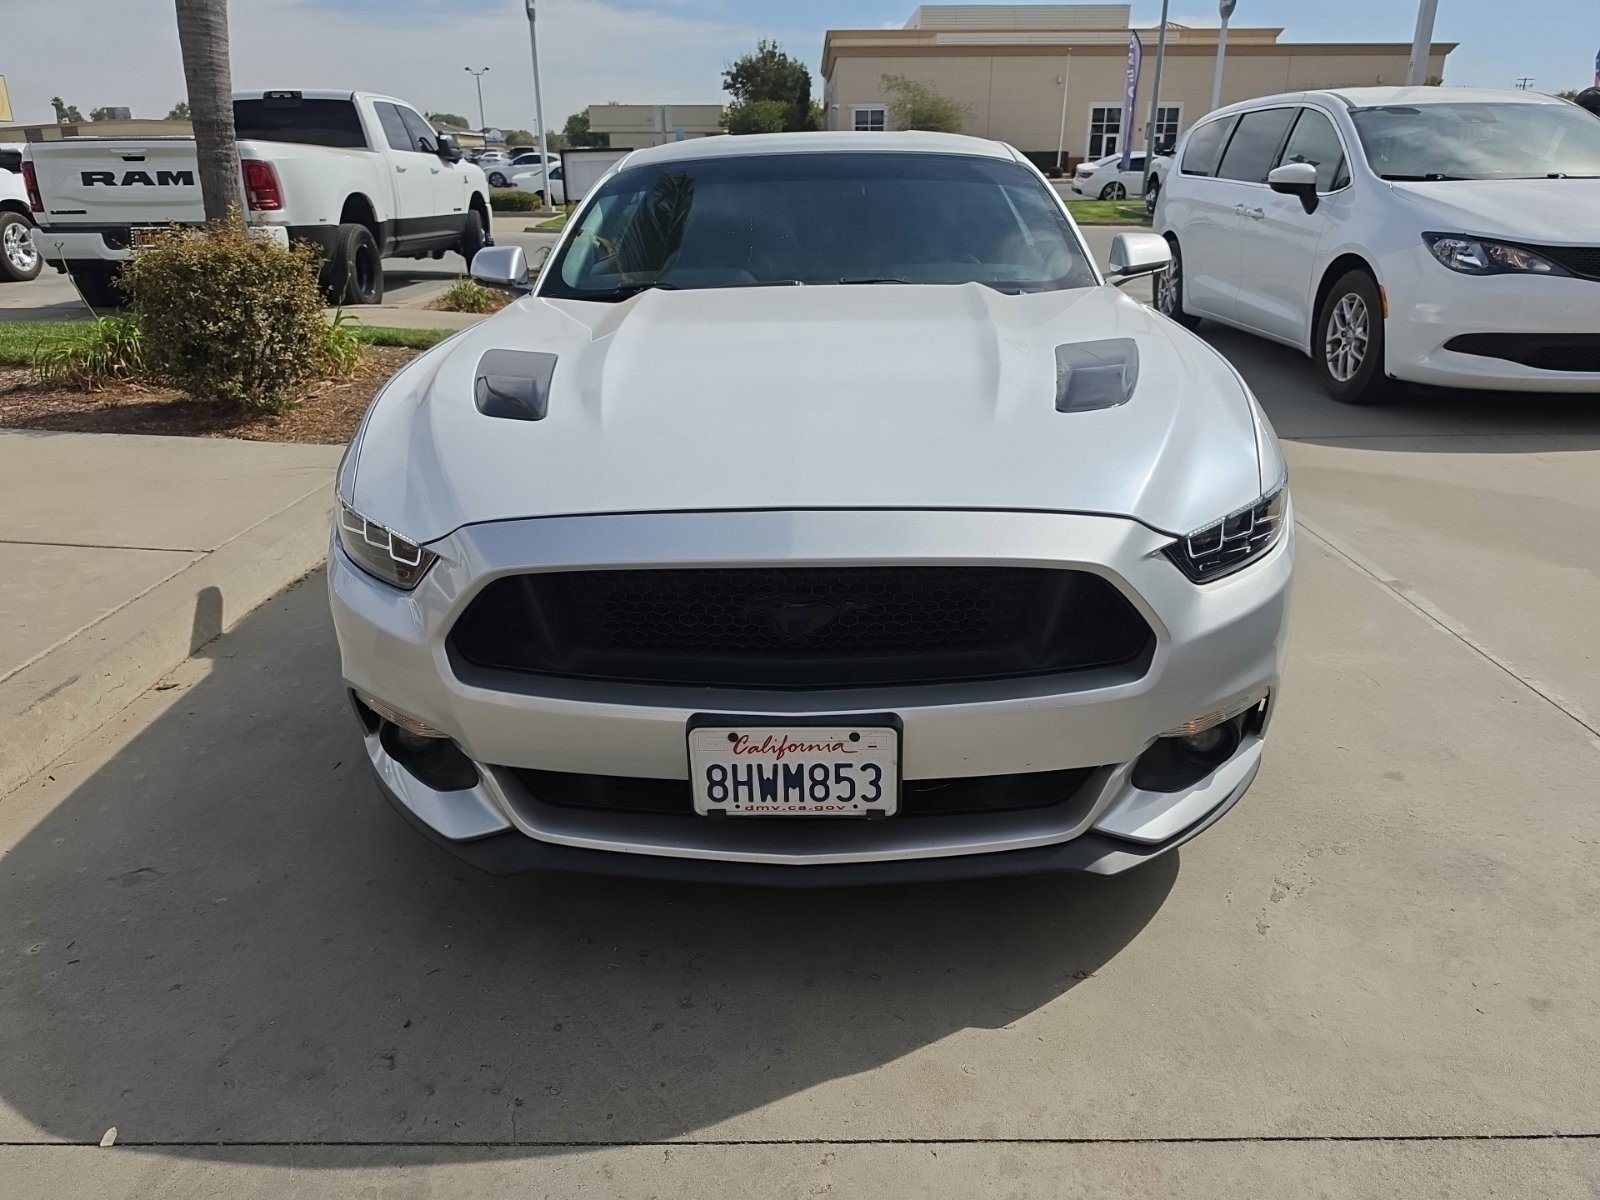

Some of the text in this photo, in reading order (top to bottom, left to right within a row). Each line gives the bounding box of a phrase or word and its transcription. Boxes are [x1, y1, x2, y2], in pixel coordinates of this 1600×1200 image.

[80, 171, 195, 187] RAM
[732, 734, 858, 761] California
[706, 763, 882, 803] 8HWM853
[744, 804, 846, 812] dmv.ca.gov
